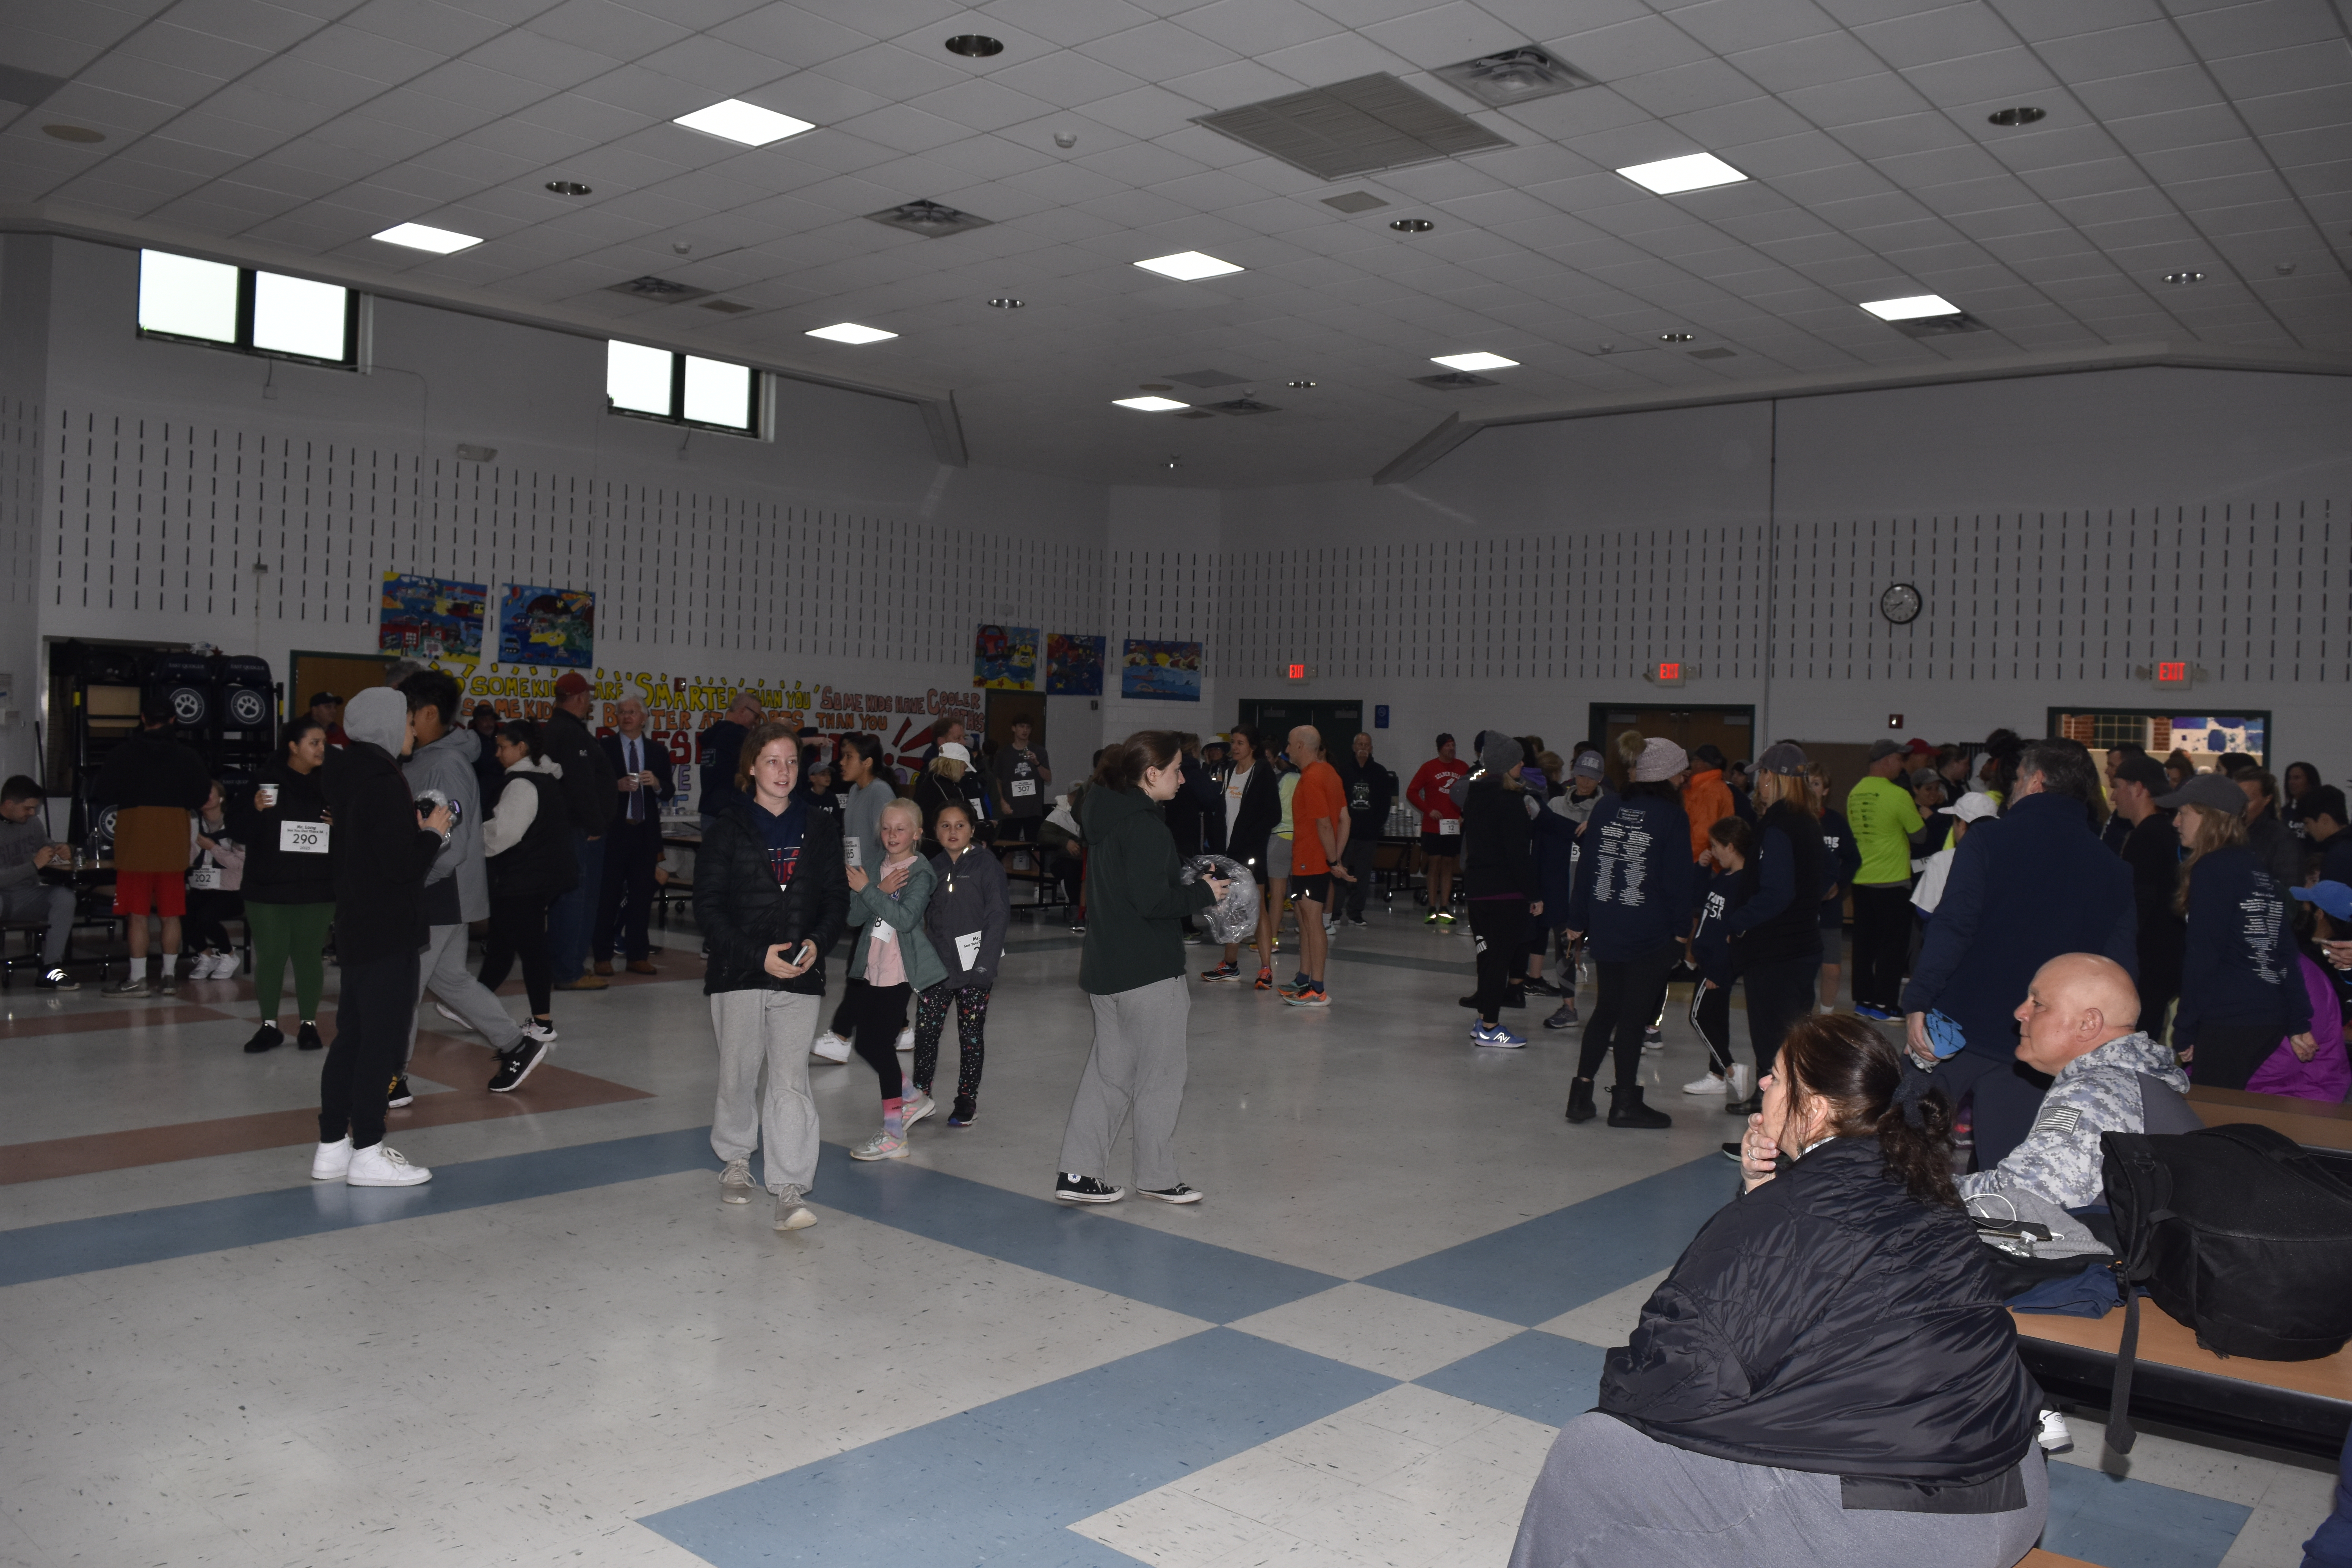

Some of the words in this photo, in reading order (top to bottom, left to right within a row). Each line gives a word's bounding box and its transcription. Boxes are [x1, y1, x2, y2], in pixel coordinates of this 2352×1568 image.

[1289, 664, 1304, 679] EXIT
[1659, 663, 1679, 679] EXIT
[2159, 662, 2185, 681] EXIT
[470, 676, 530, 698] SOME
[785, 691, 810, 710] YOU
[865, 694, 892, 712] KIDS
[895, 696, 925, 714] HAVE
[816, 712, 854, 729] THAN
[859, 713, 887, 731] YOU
[292, 833, 317, 845] 290
